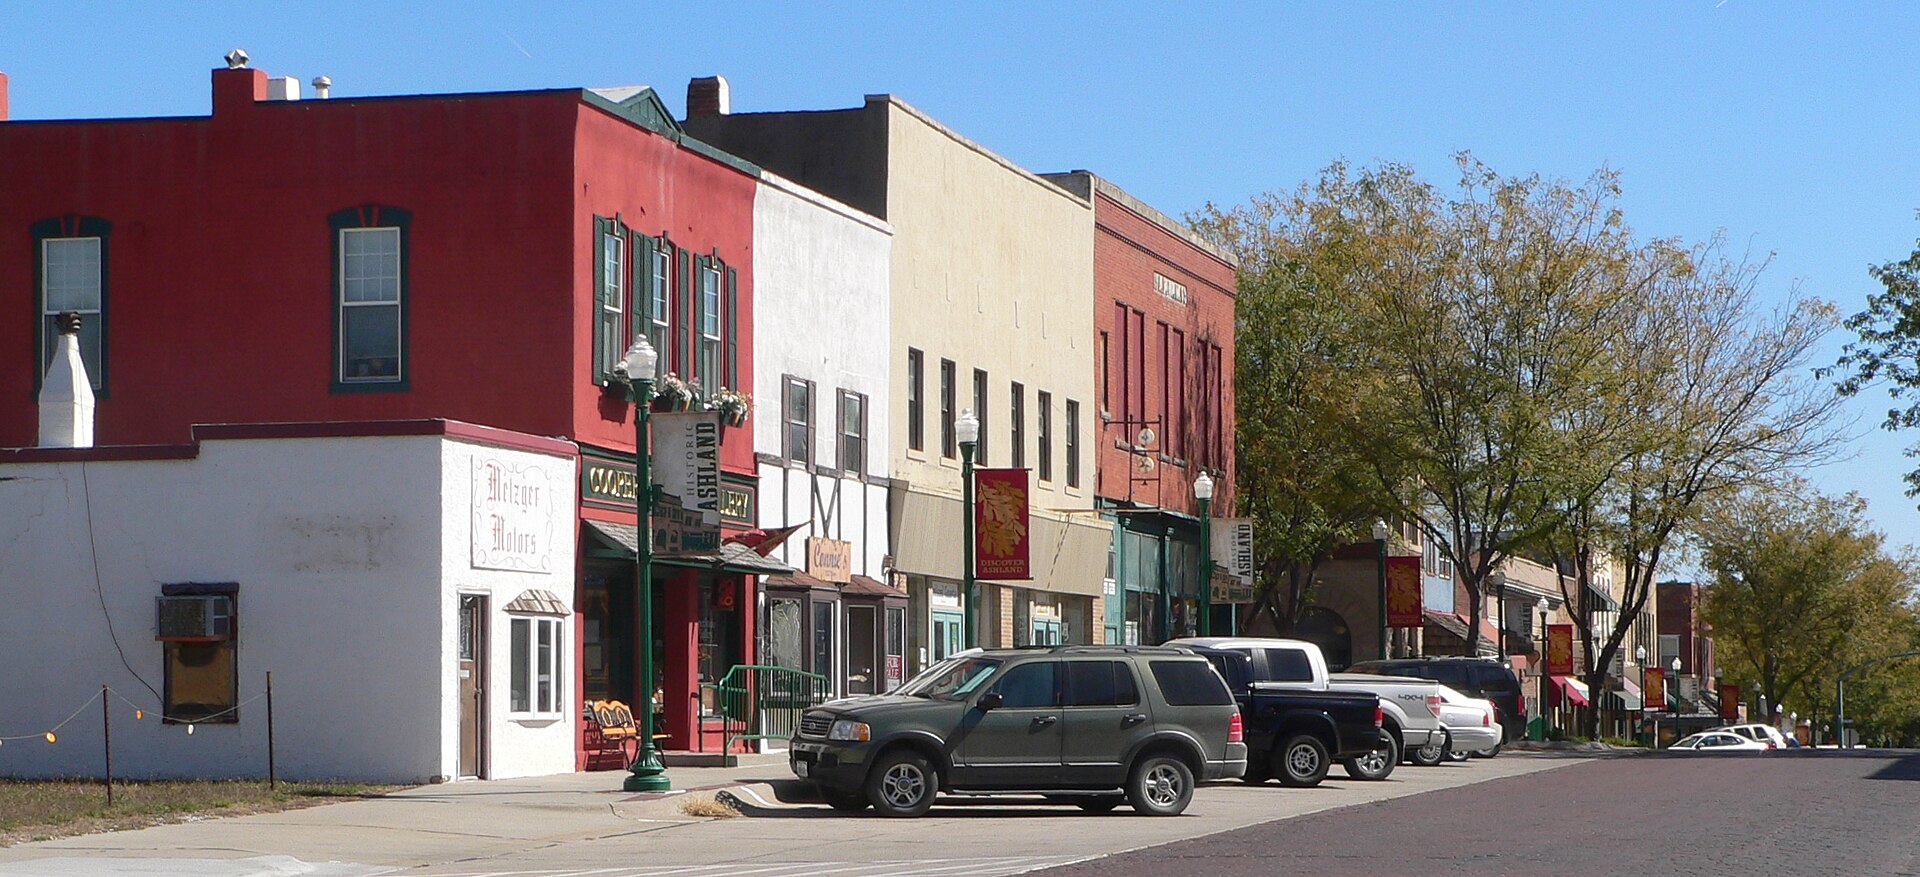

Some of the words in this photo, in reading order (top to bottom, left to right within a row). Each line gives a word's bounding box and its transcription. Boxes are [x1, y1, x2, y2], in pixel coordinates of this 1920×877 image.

[686, 422, 695, 496] HISTORIC
[696, 422, 718, 512] ASHLAND
[486, 463, 540, 514] Metzger
[720, 489, 749, 518] LERY
[491, 513, 536, 555] Motors
[814, 542, 848, 570] Connie's
[1238, 524, 1251, 577] ASHLAND
[982, 566, 1023, 574] ASHLAND
